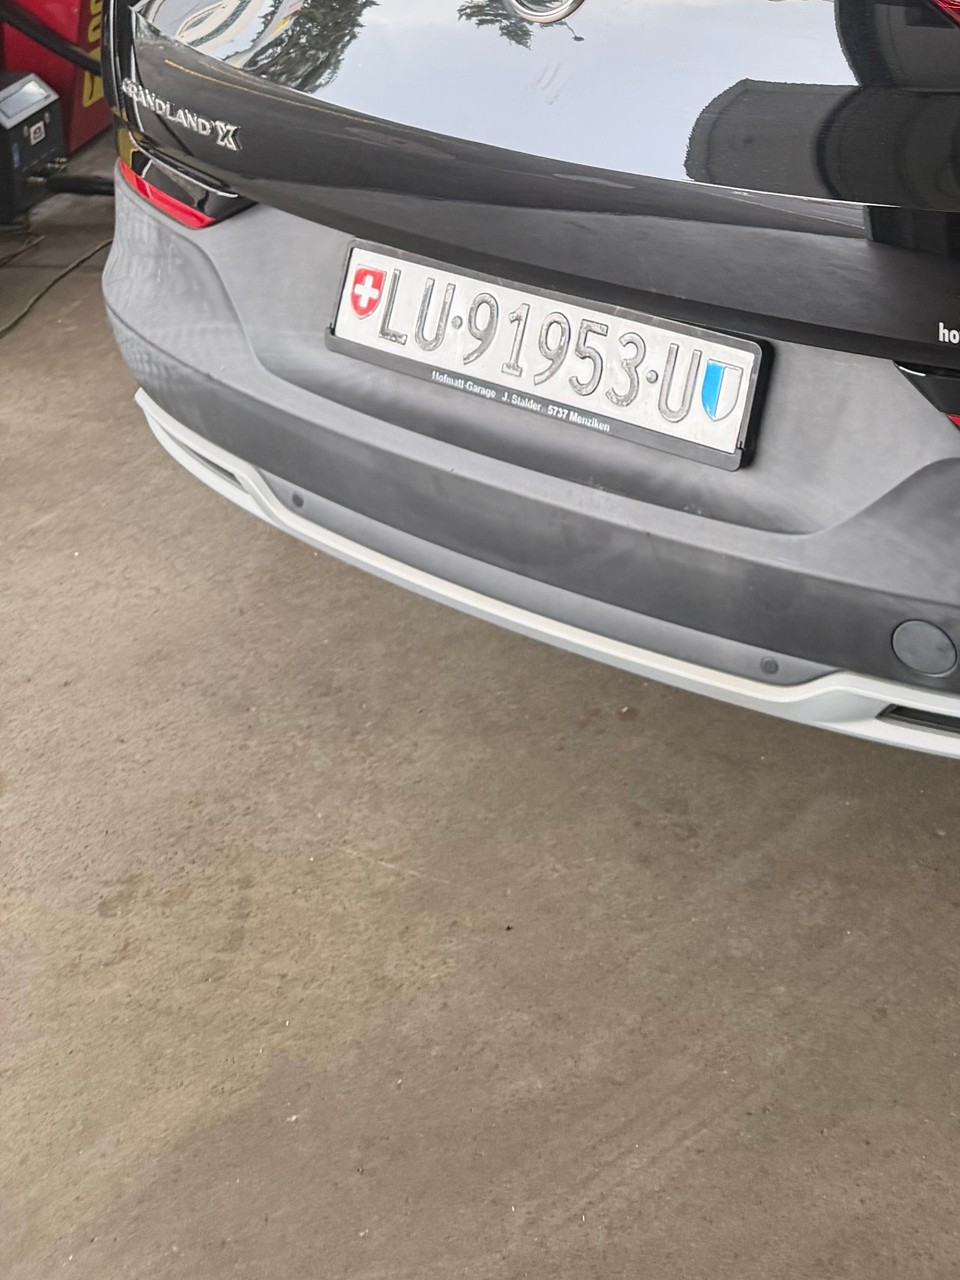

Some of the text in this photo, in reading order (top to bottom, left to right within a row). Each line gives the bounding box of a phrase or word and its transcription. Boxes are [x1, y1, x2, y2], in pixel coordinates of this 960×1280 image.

[121, 77, 243, 151] GRANDLAND X
[548, 405, 568, 419] 5737
[569, 411, 611, 433] Menziken
